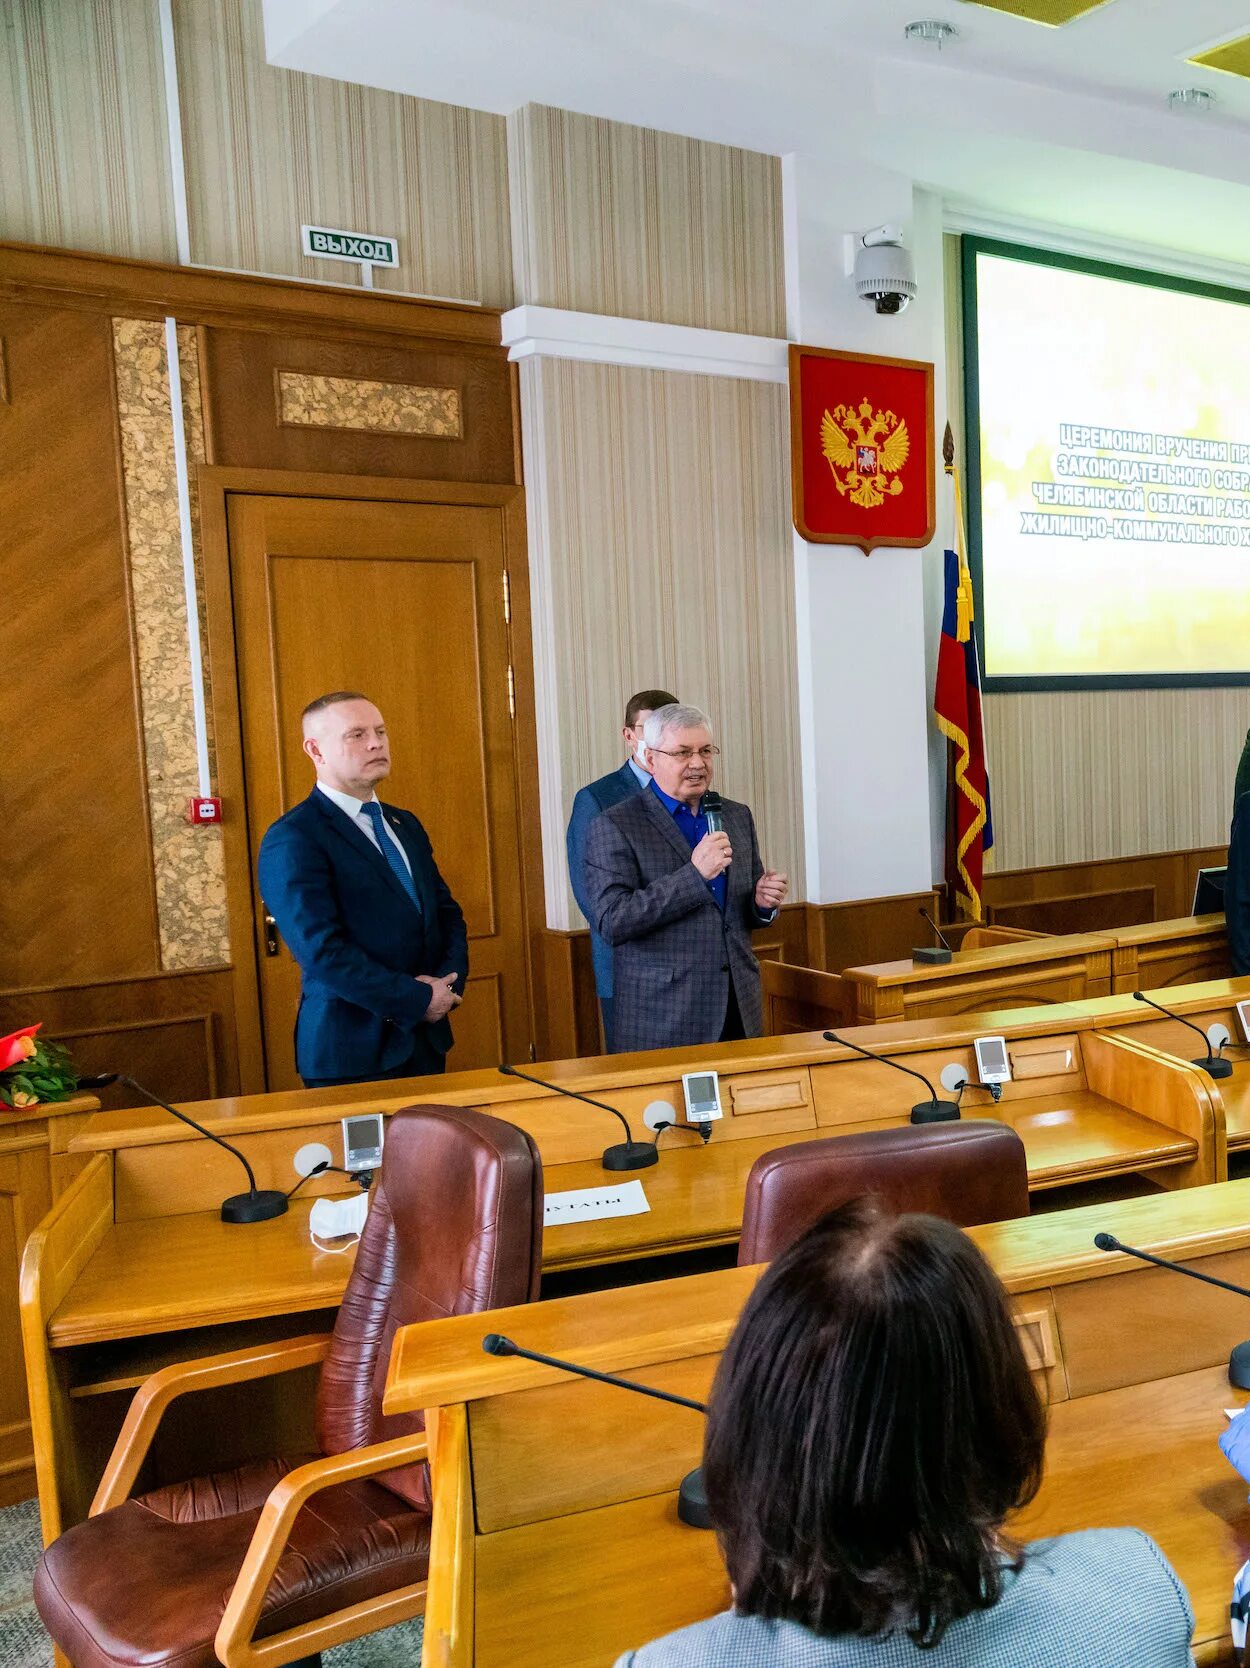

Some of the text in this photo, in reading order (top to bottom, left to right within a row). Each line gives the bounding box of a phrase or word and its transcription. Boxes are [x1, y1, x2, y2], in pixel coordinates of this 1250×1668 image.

[312, 233, 390, 261] ВЫХОД
[1060, 423, 1152, 454] ЦЕРЕМОНИЯ
[1155, 434, 1228, 462] ВРУЧЕНИЯ
[1057, 453, 1212, 488] ЗАКОНОДАТЕЛЬНОГО
[1032, 482, 1145, 512] ЧЕЛЯБИНСКОЙ
[1148, 492, 1213, 517] ОБЛАСТИ
[1020, 511, 1240, 546] ЖИЛИЩНО-КОММУНАЛЬНОГО
